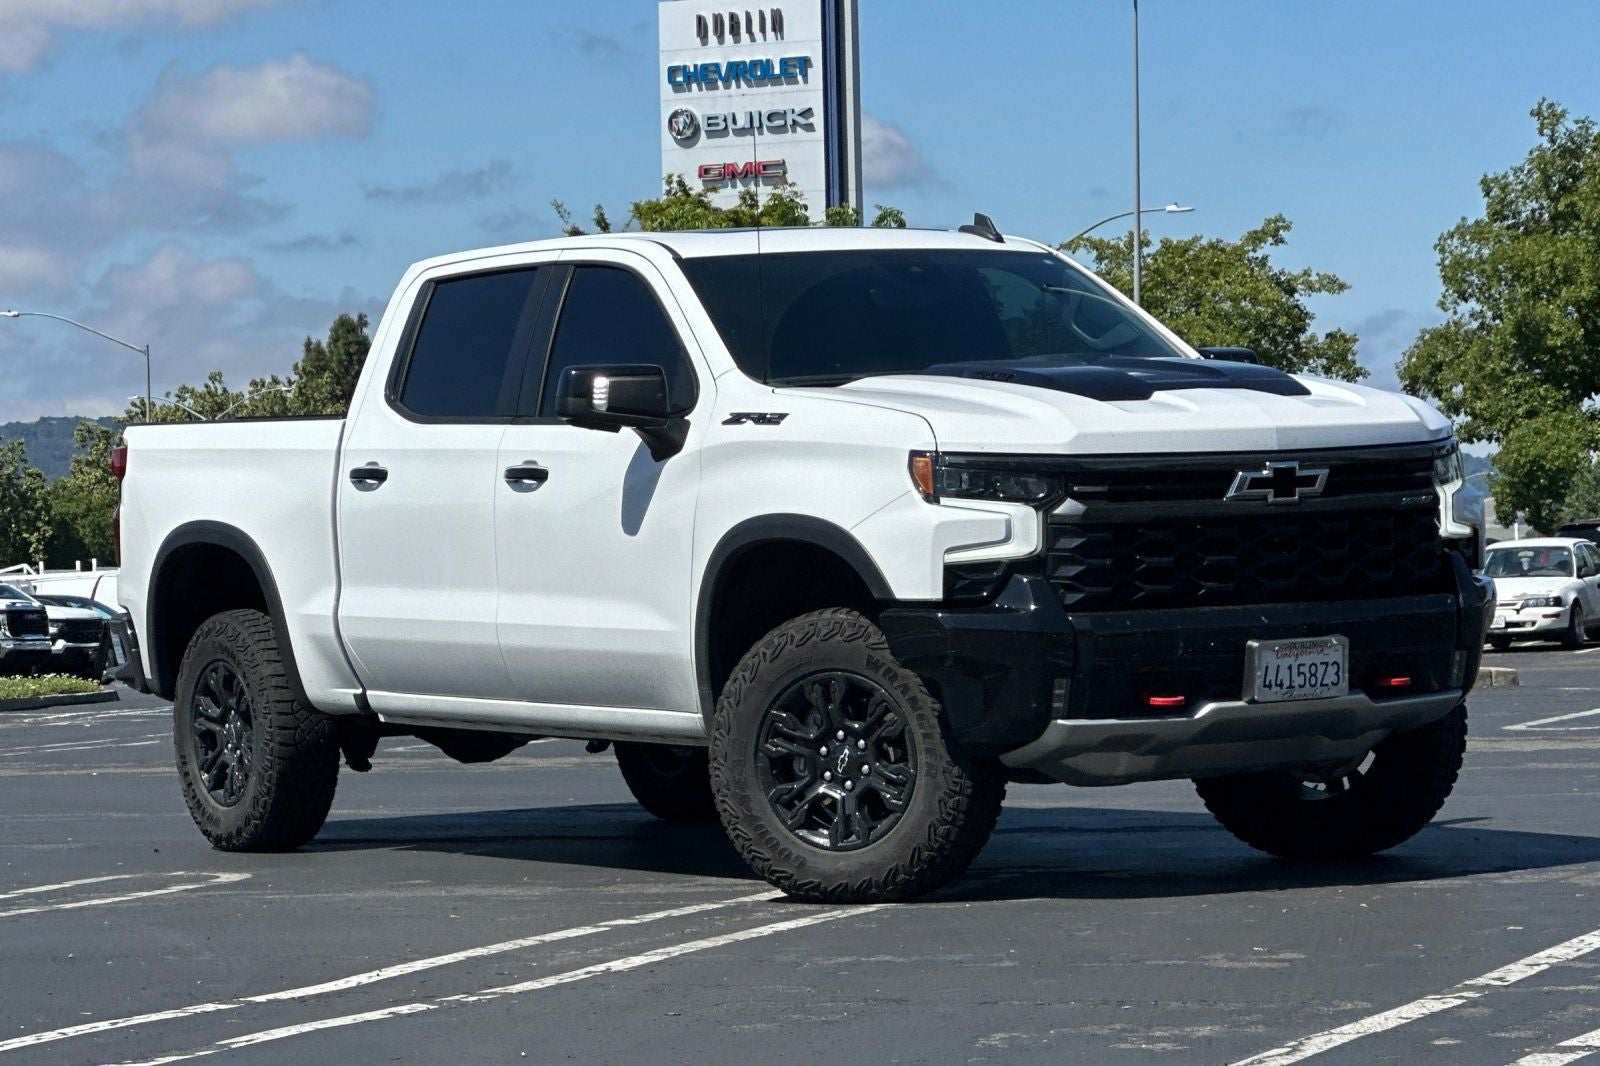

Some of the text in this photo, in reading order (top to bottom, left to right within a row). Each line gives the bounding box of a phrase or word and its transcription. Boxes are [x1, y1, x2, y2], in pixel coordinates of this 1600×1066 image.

[696, 8, 784, 39] DUBLIN
[667, 56, 812, 85] CHEVROLET
[701, 107, 813, 131] BUICK
[698, 160, 786, 180] GMC
[1262, 661, 1341, 690] 44158Z3
